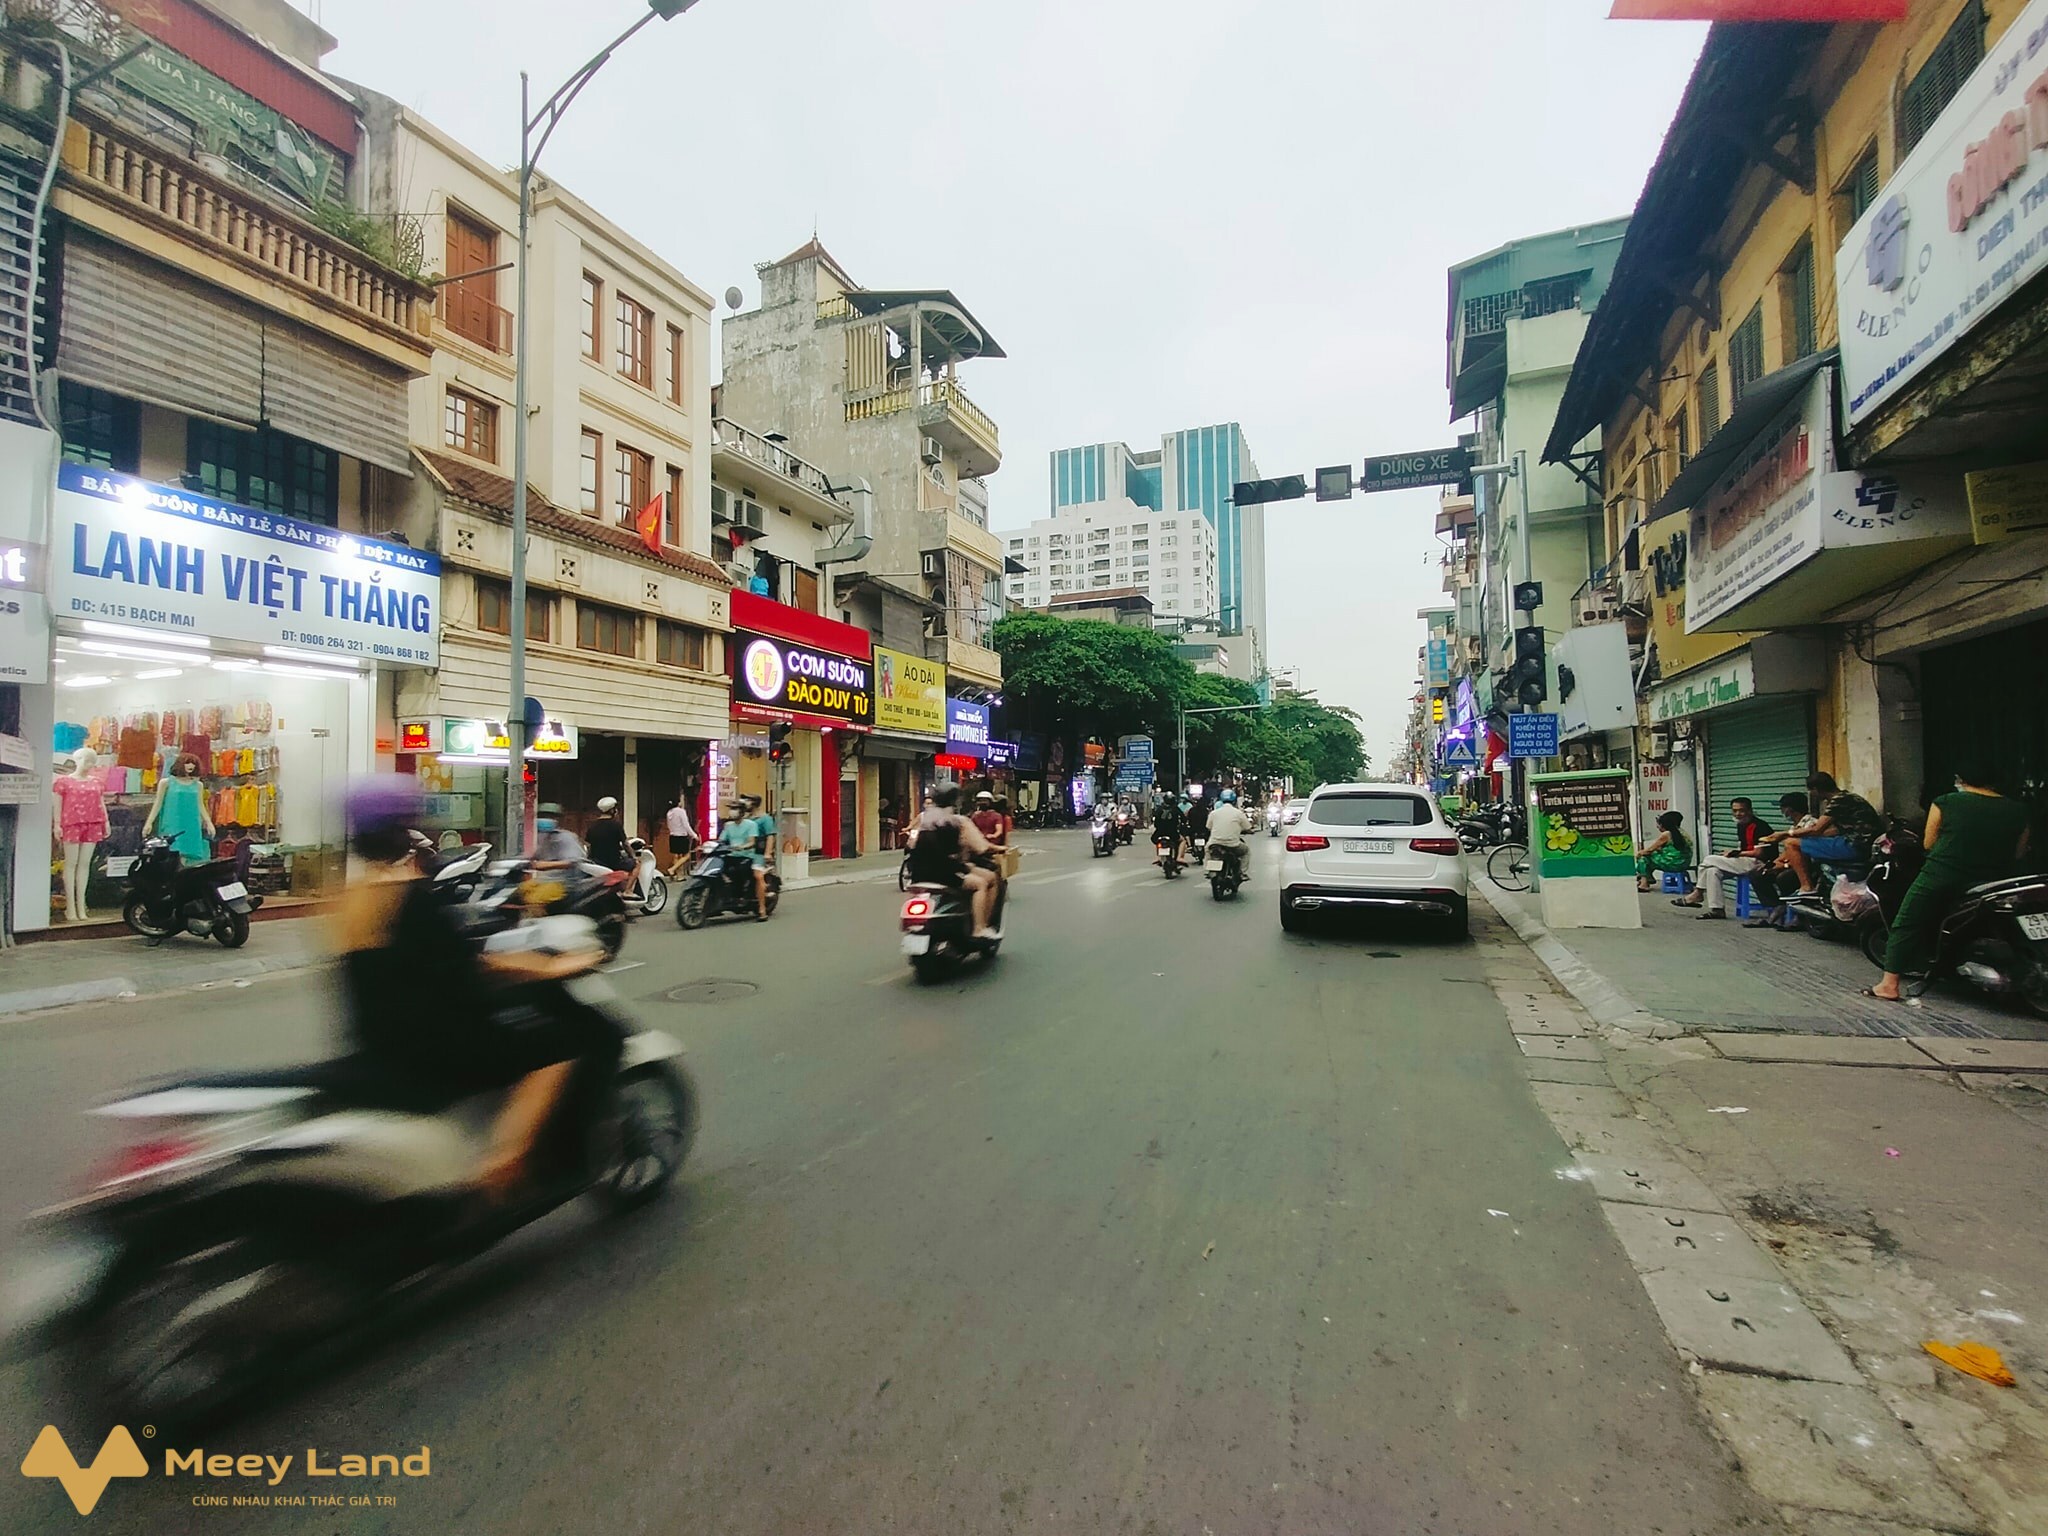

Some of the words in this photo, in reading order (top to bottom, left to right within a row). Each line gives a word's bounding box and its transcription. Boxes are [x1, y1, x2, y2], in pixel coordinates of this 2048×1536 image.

[140, 51, 186, 84] MUA
[1430, 454, 1448, 470] XE
[1832, 496, 1927, 529] ELENCO
[203, 507, 244, 526] BÁN
[250, 515, 272, 533] LẺ
[275, 522, 312, 543] SẢN
[396, 554, 428, 570] MAY
[73, 523, 204, 595] LANH
[221, 553, 308, 619] VIỆT
[320, 570, 431, 634] THẮNG
[100, 602, 126, 617] 415
[130, 606, 167, 623] BẠCH
[170, 613, 195, 628] MAI
[300, 631, 324, 646] 0906
[327, 636, 344, 649] 264
[347, 639, 363, 651] 321
[373, 643, 395, 656] 0904
[397, 647, 412, 659] 868
[415, 650, 430, 661] 182
[787, 650, 826, 678] CƠM
[827, 658, 865, 689] SƯỜN
[787, 676, 822, 706] ĐÀO
[823, 687, 851, 710] DUY
[1648, 799, 1669, 811] NHƯ
